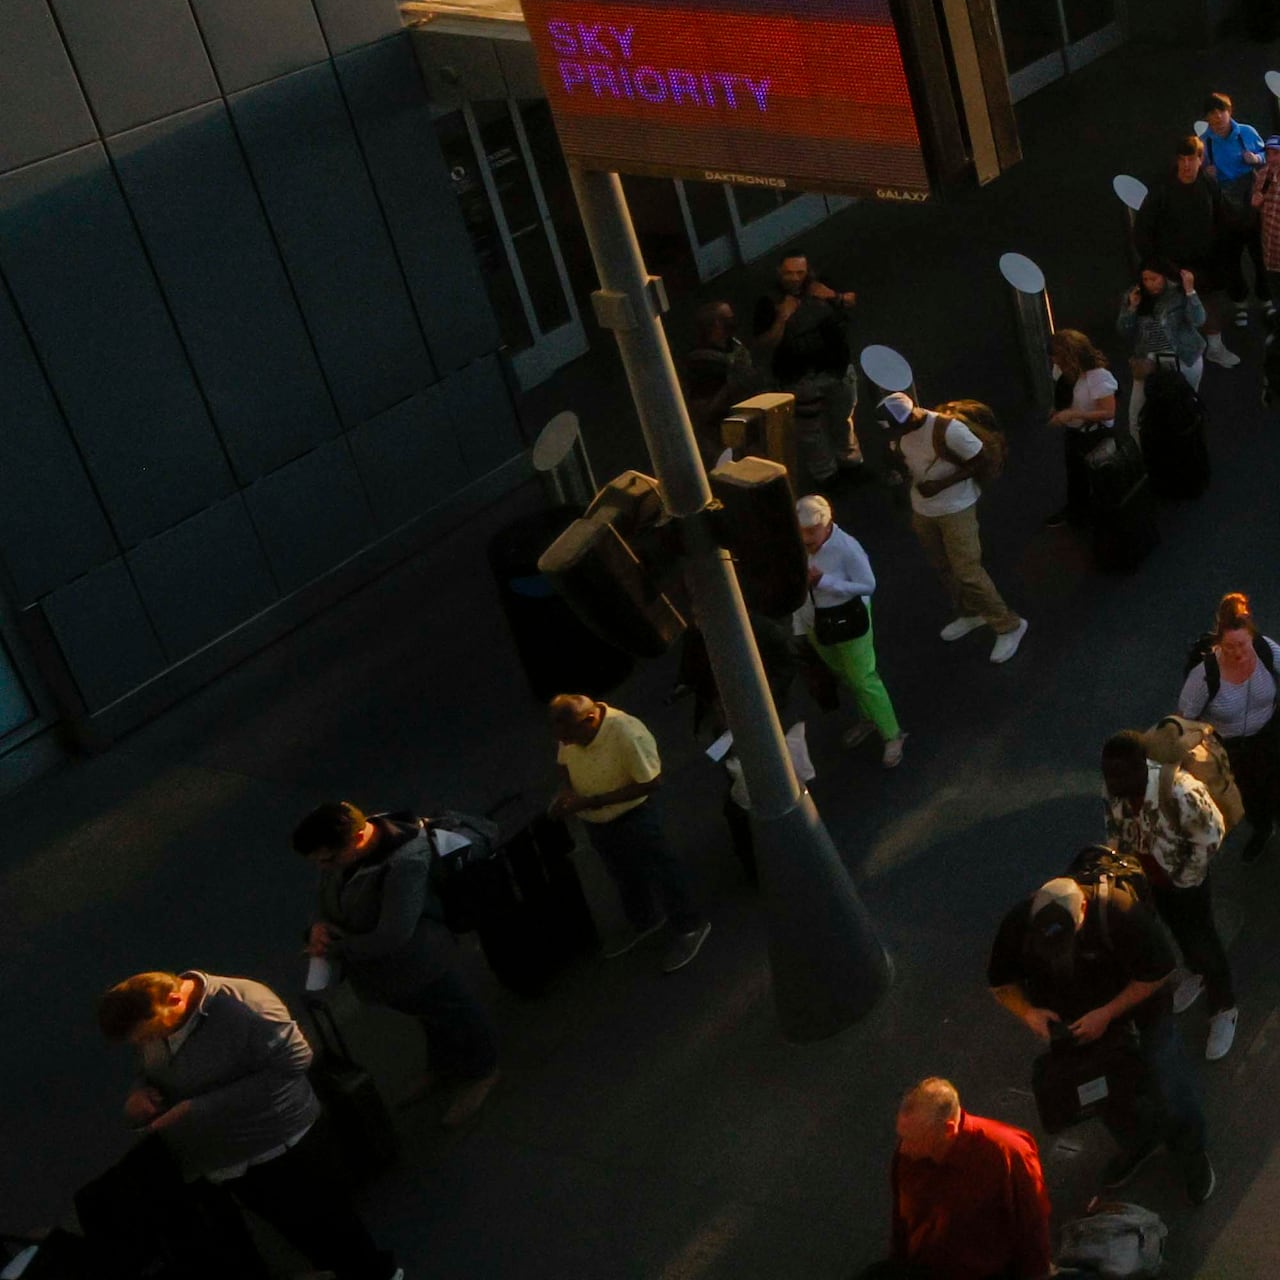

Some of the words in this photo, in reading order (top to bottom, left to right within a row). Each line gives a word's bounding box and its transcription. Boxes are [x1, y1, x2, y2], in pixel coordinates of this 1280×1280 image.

[548, 18, 634, 60] SKY
[558, 58, 771, 113] PRIORITY
[704, 171, 786, 188] DAKTRONICS
[876, 188, 928, 202] GALAXY
